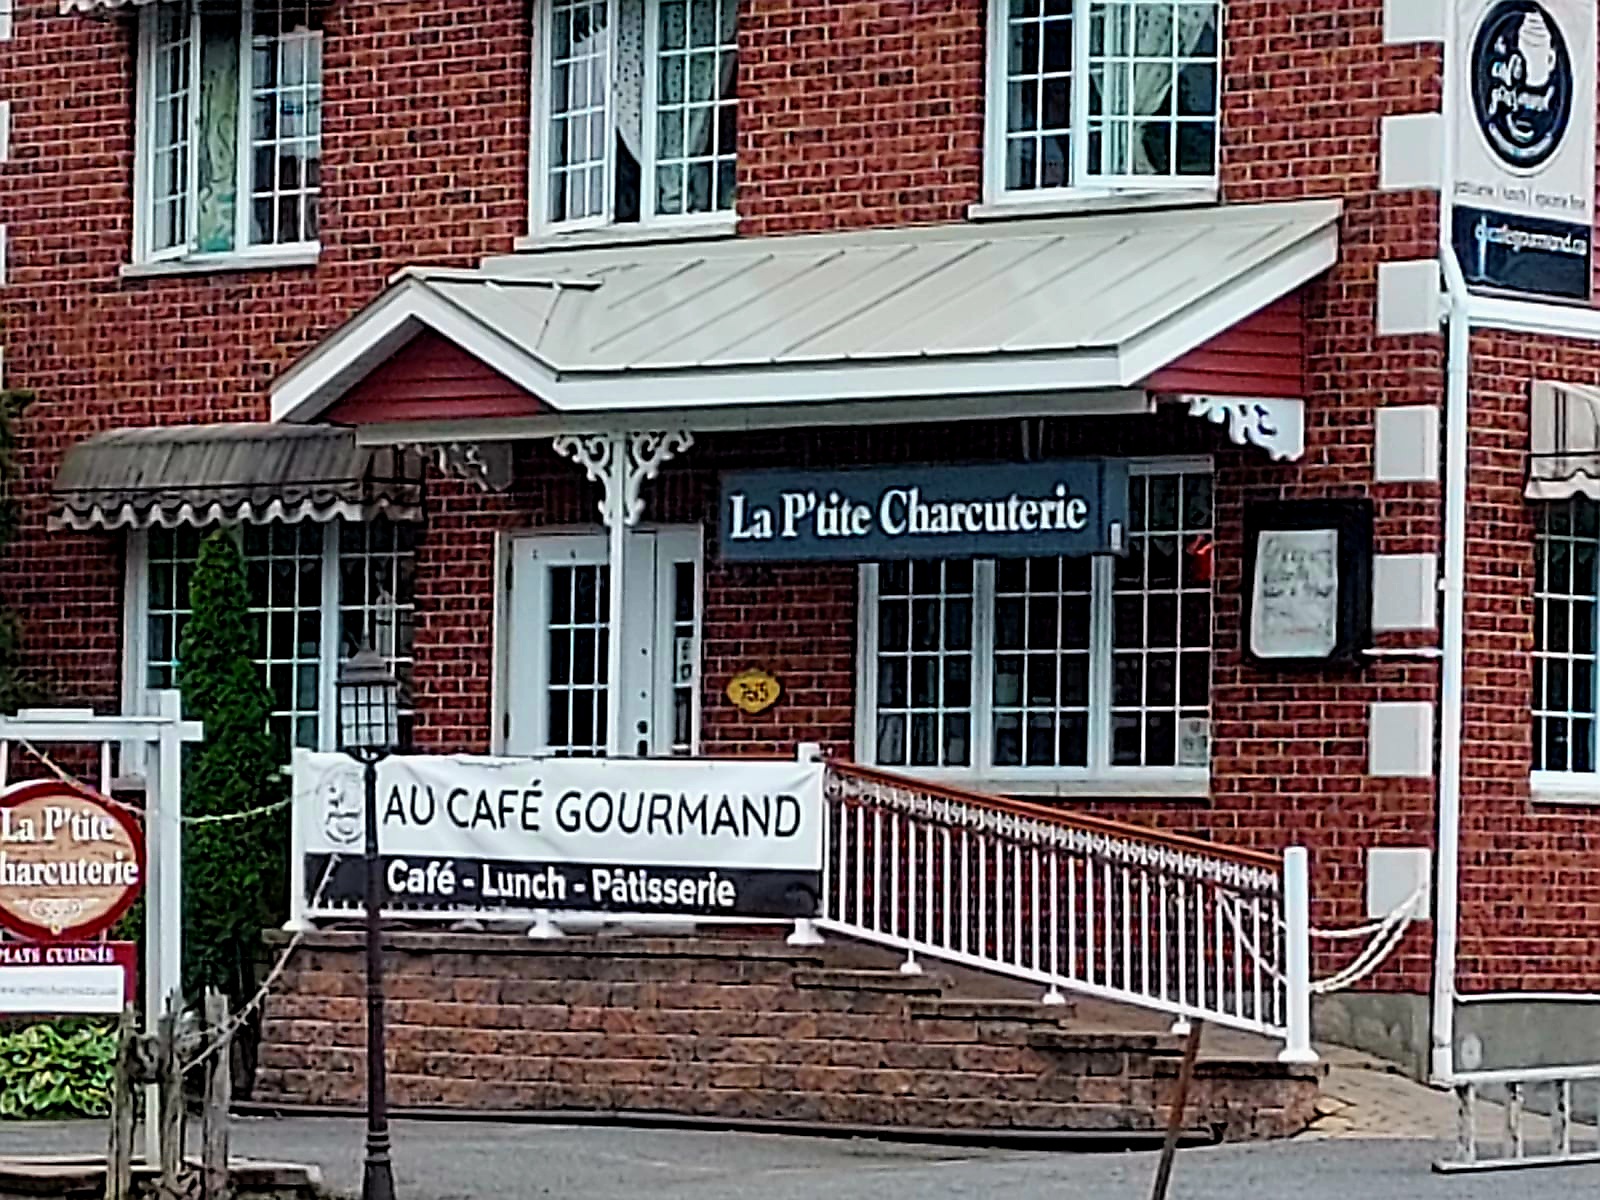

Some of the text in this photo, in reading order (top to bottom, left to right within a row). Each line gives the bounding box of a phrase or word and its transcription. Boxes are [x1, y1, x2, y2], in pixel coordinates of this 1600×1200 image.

[730, 484, 1089, 539] La P'tite Charcuterie
[0, 806, 115, 842] La P'tite
[383, 779, 801, 838] AU CAFÉ GOURMAND
[0, 849, 139, 887] harcuterie
[387, 860, 454, 894] Café
[481, 864, 566, 901] Lunch
[591, 868, 737, 908] Pâtisserie
